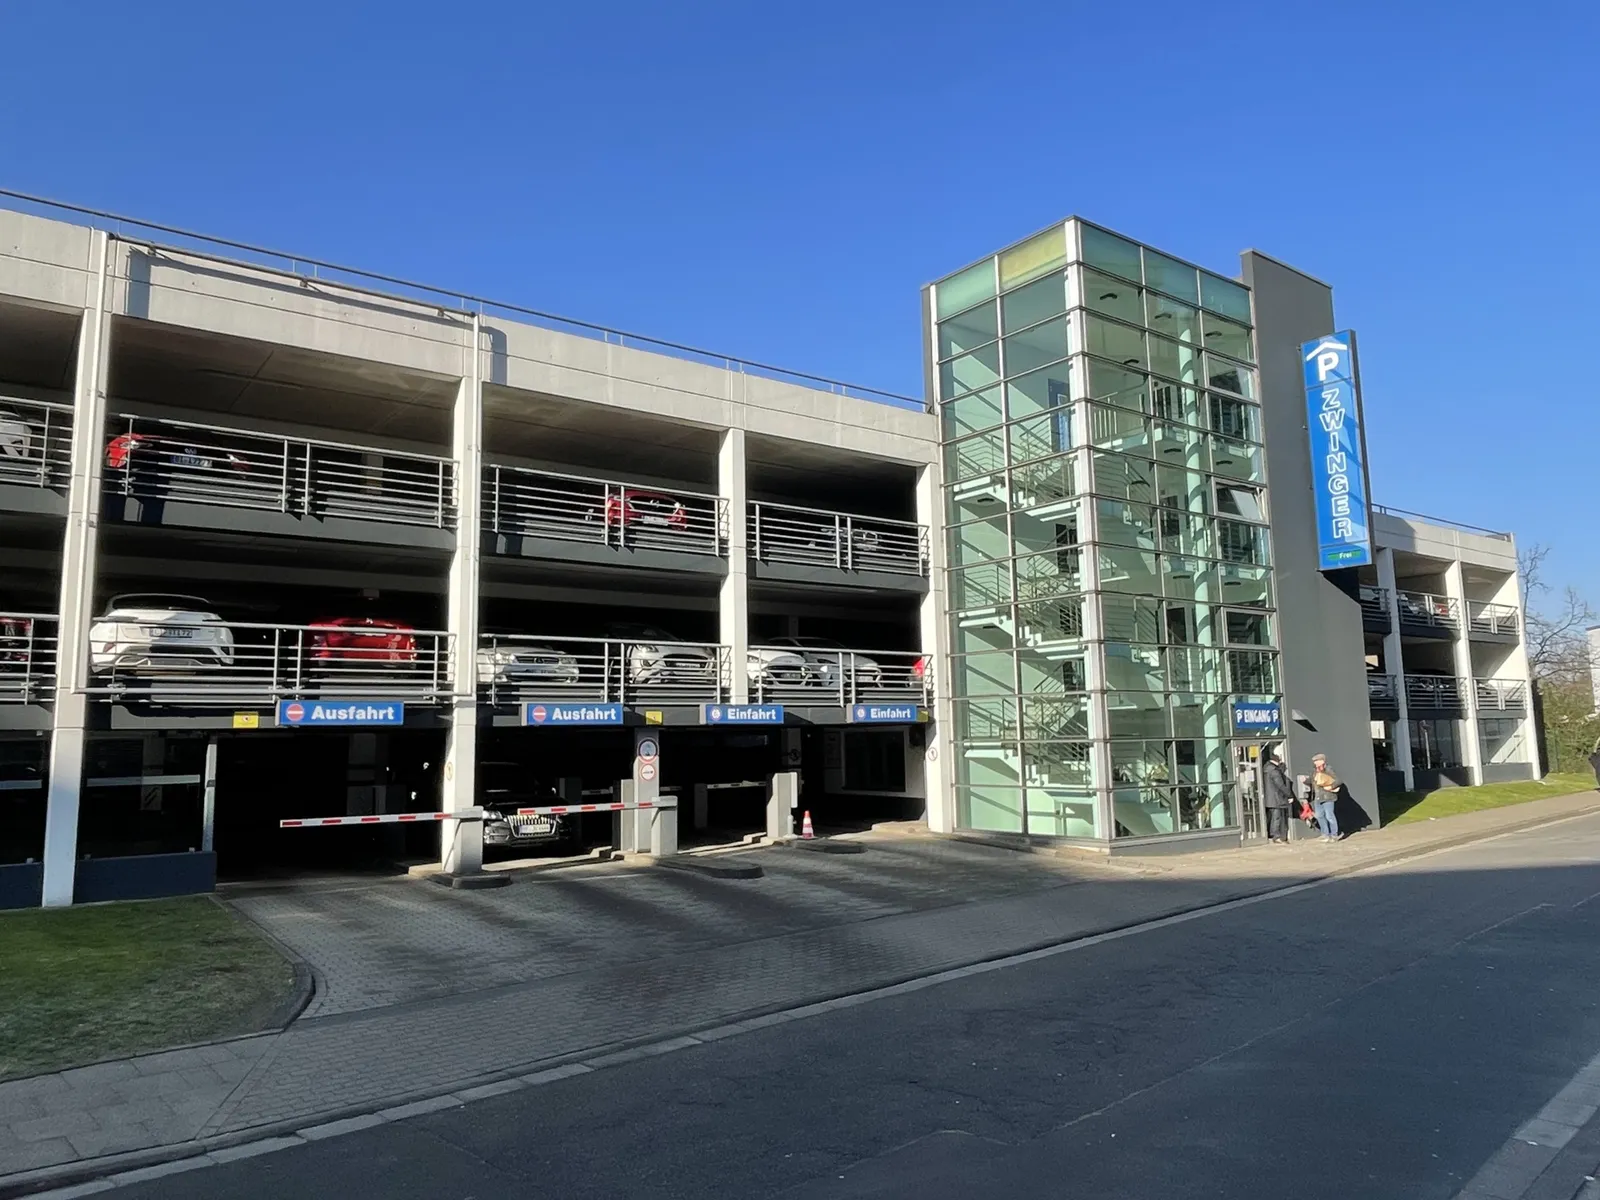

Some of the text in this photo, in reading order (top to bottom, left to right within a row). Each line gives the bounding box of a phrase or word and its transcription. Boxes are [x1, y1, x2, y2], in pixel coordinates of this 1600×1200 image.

[1317, 352, 1340, 381] P
[1319, 388, 1353, 538] ZWINGER
[311, 705, 395, 720] Ausfahrt
[552, 707, 616, 720] Ausfahrt
[727, 707, 776, 720] Einfahrt
[870, 708, 911, 719] Einfahrt
[1244, 709, 1271, 723] EINGANG
